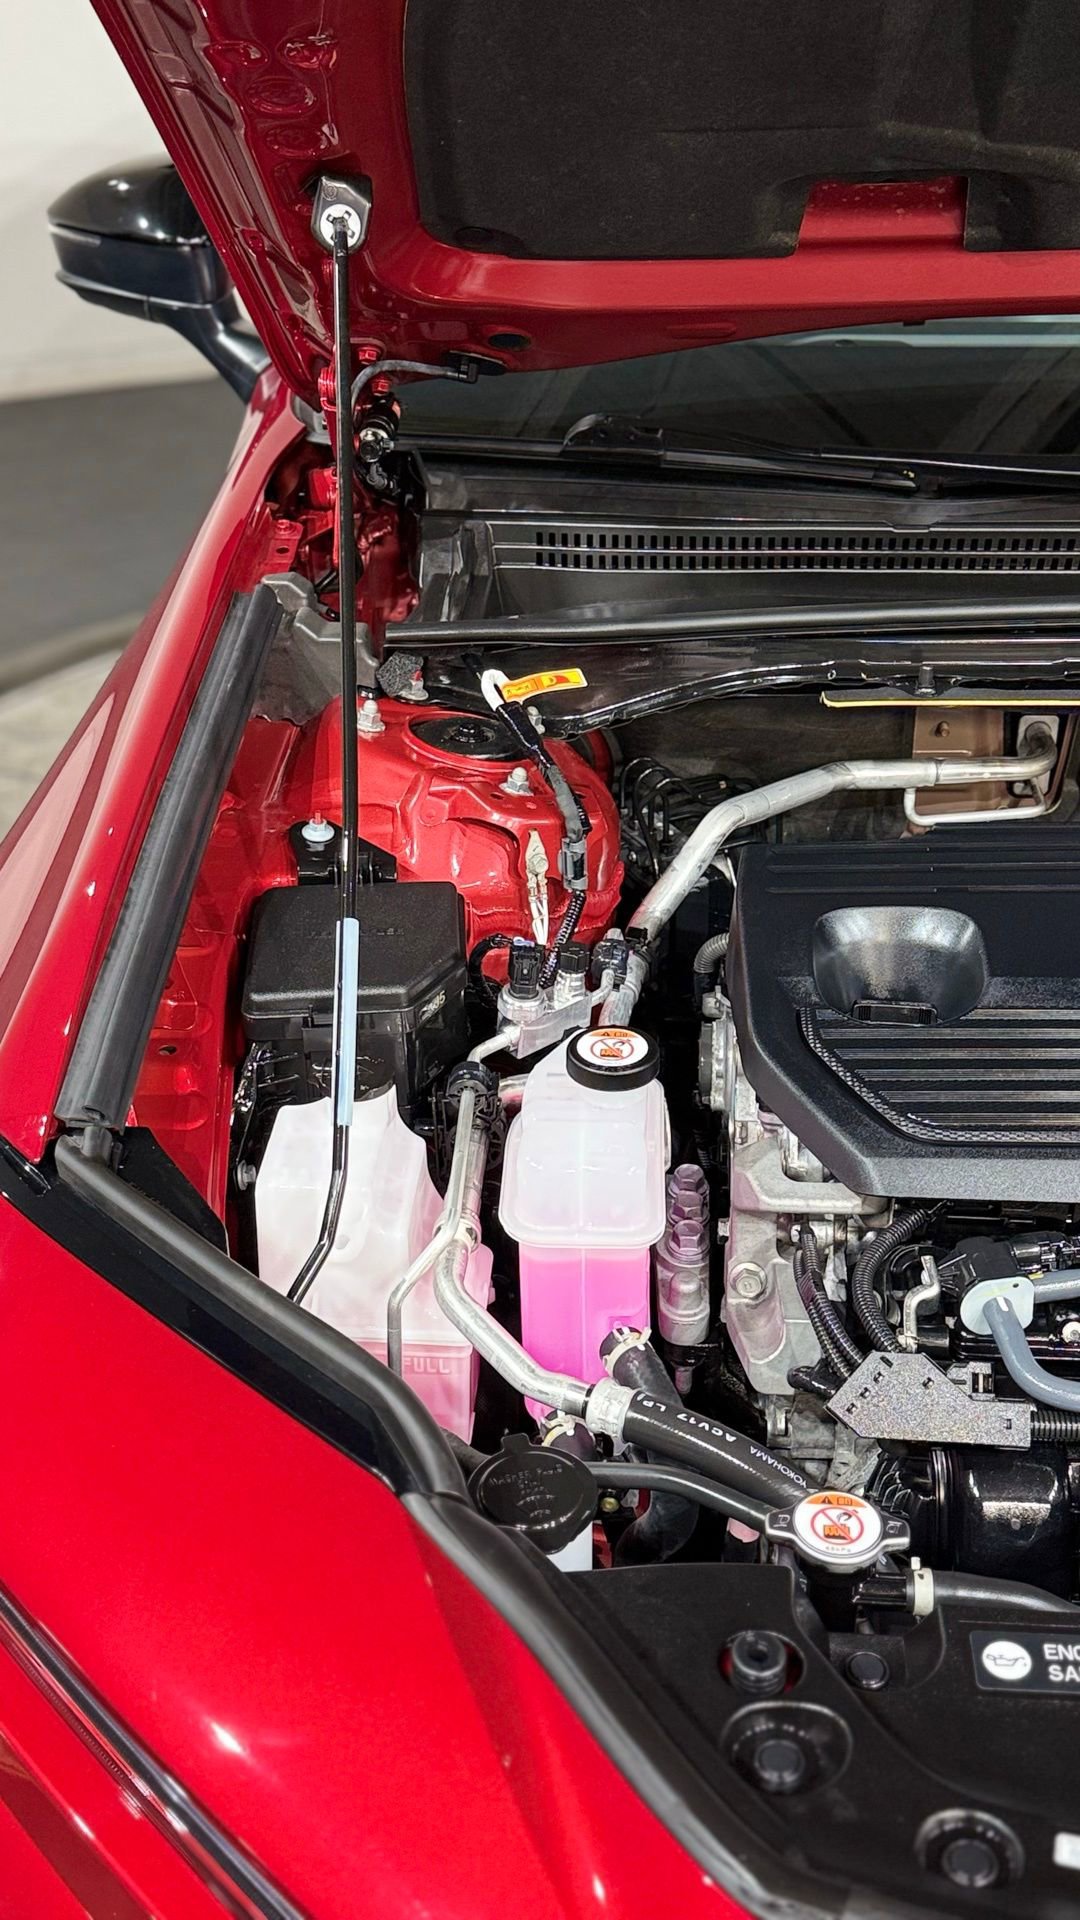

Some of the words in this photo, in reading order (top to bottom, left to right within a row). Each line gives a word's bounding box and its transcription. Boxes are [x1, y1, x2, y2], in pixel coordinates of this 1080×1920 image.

[403, 1357, 450, 1374] FULL
[676, 1413, 737, 1442] ACV17
[750, 1445, 807, 1489] YOKOHAMA
[1048, 1664, 1080, 1682] SA
